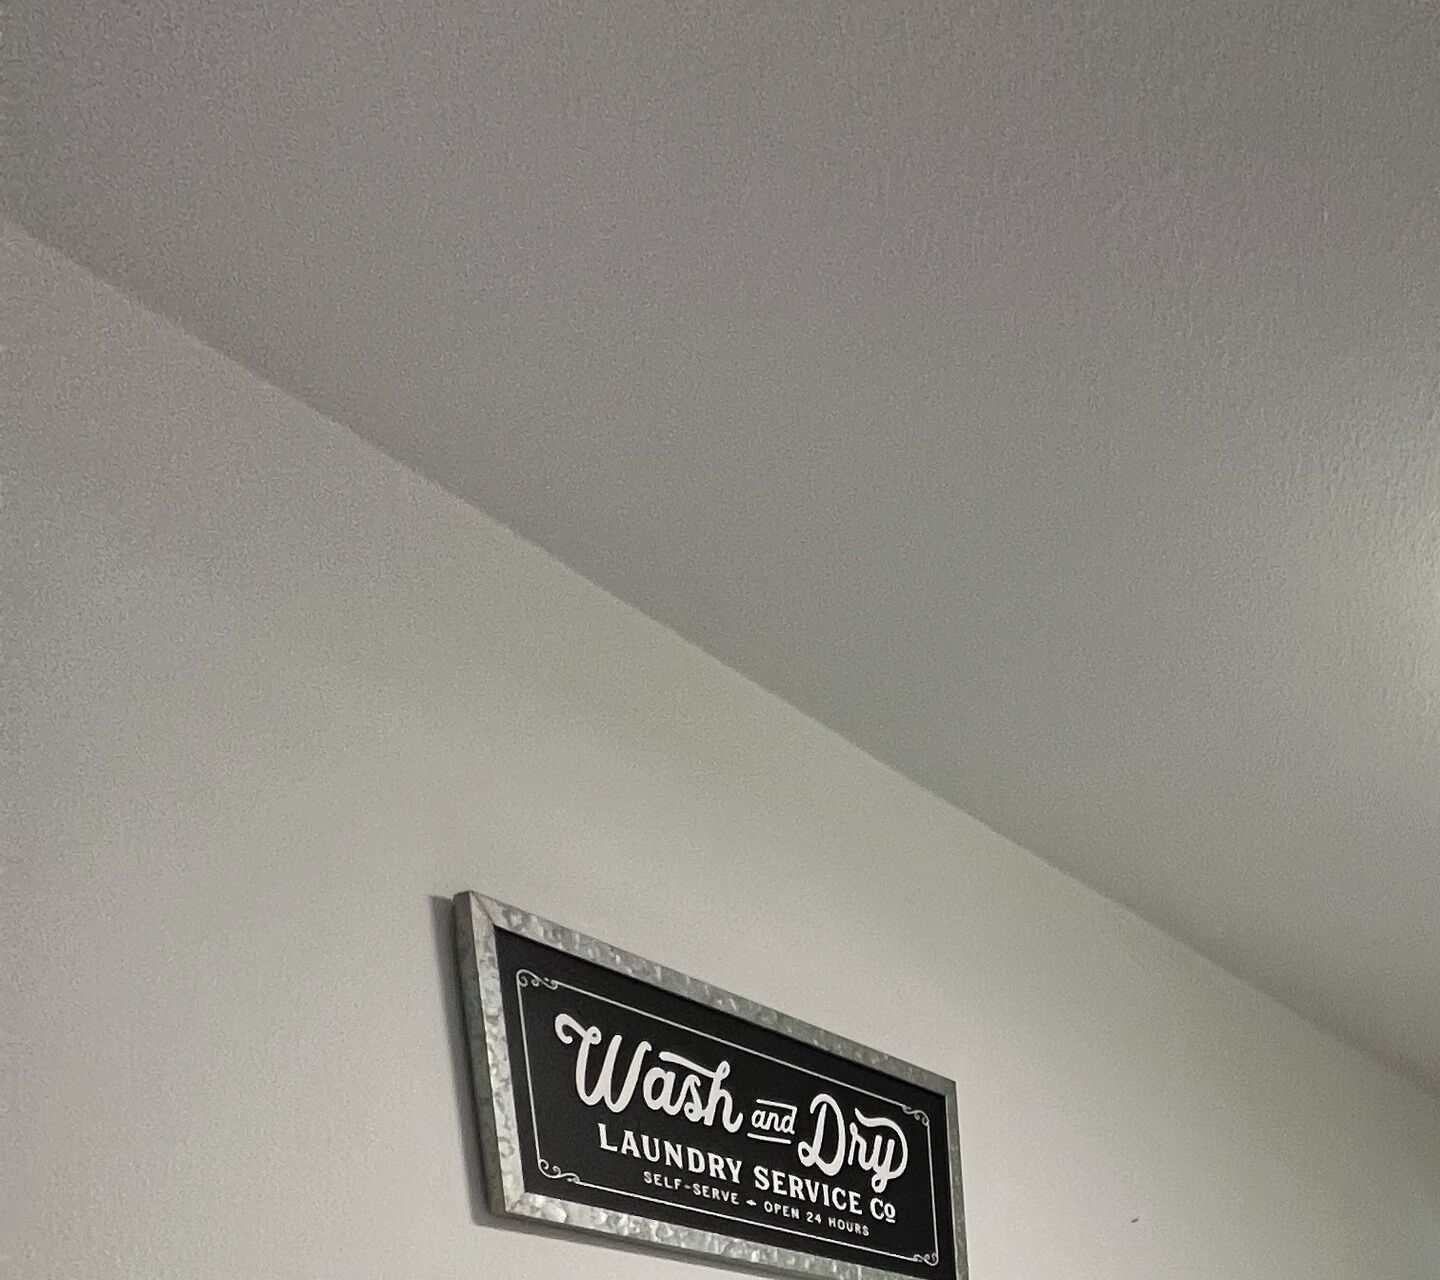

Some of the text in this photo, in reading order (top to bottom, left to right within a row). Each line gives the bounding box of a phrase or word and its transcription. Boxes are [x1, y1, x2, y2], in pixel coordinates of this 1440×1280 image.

[555, 1013, 908, 1193] Wash and Dry
[597, 1123, 742, 1184] LAUNDRY
[753, 1165, 863, 1215] SERVICE
[643, 1171, 870, 1237] SELF-SERVE OPEN 24 HOURS
